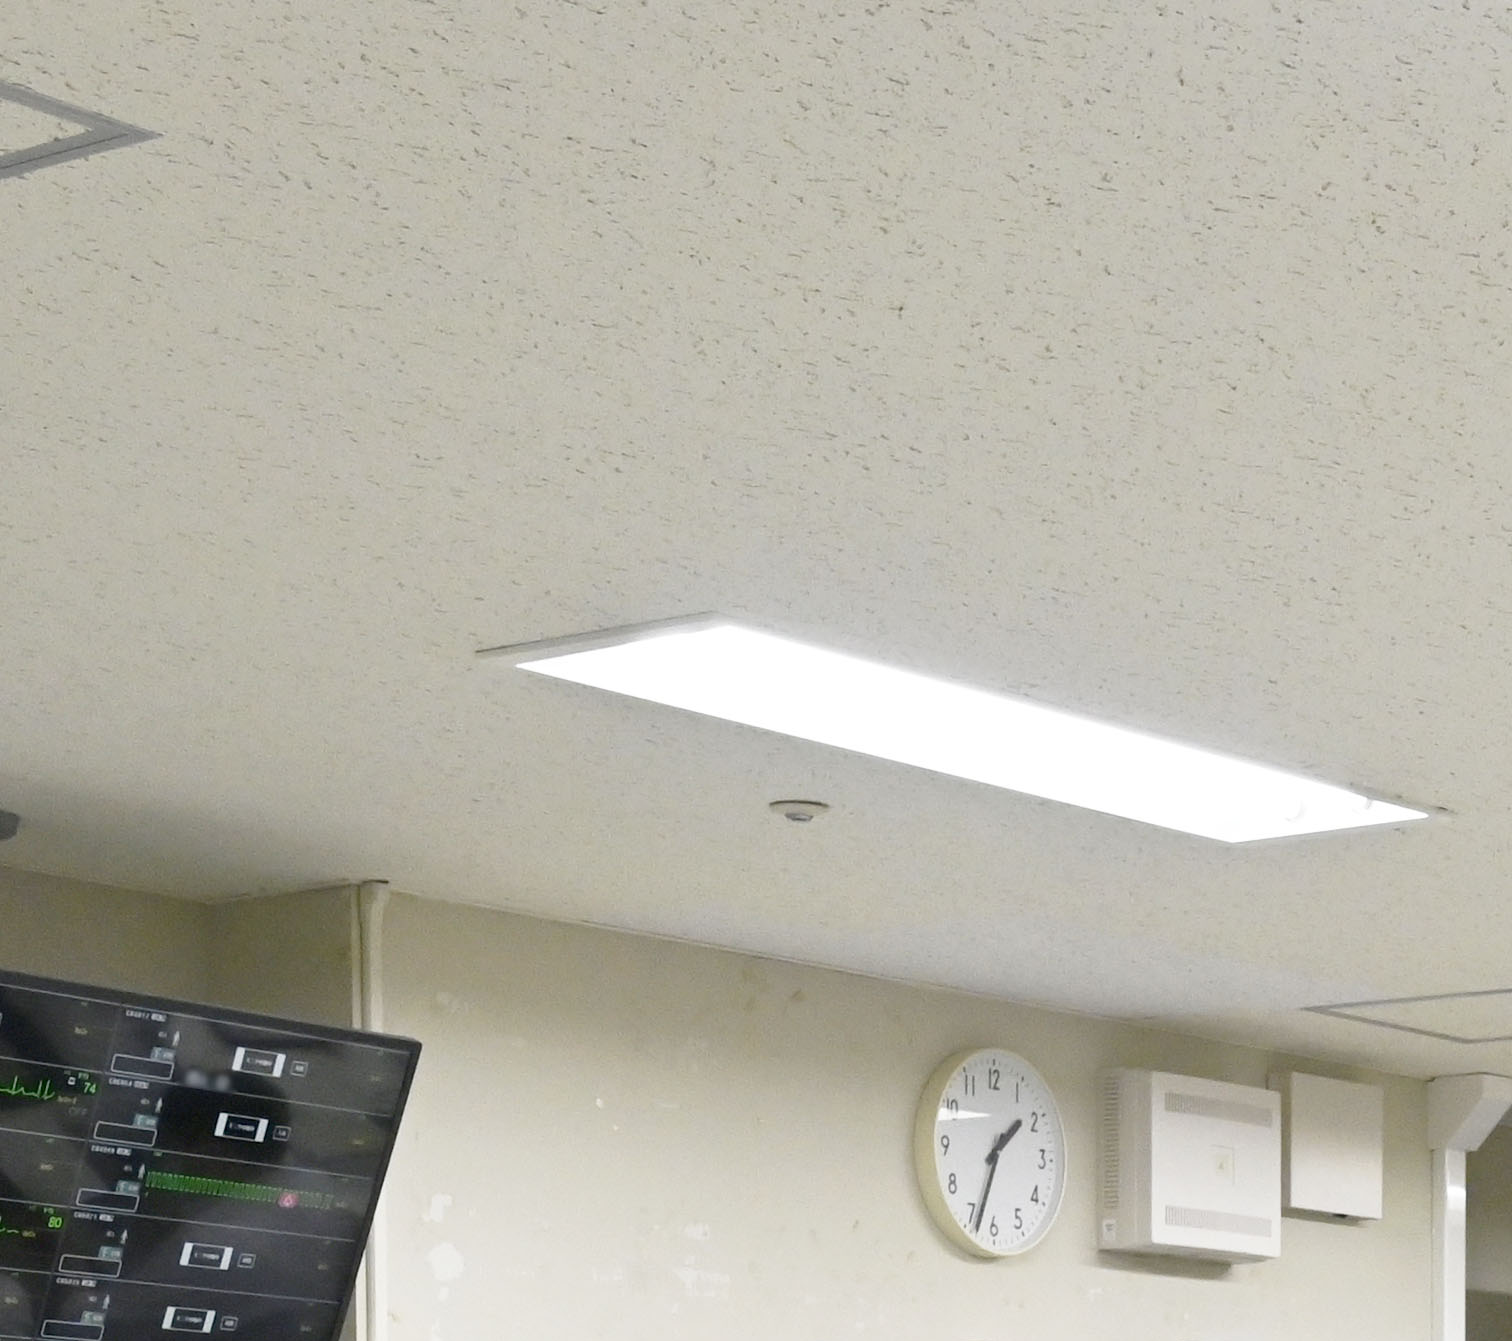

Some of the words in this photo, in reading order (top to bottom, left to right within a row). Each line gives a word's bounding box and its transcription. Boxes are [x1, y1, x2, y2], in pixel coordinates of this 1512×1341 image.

[84, 1082, 96, 1094] 74
[964, 1075, 975, 1096] 11
[988, 1069, 1001, 1092] 12
[1015, 1082, 1020, 1103] 1
[1030, 1112, 1039, 1132] 2
[941, 1135, 950, 1156] 9
[1037, 1149, 1047, 1170] 3
[947, 1173, 958, 1194] 8
[1030, 1185, 1039, 1204] 4
[967, 1203, 976, 1224] 7
[1014, 1208, 1023, 1229] 5
[989, 1216, 999, 1237] 6
